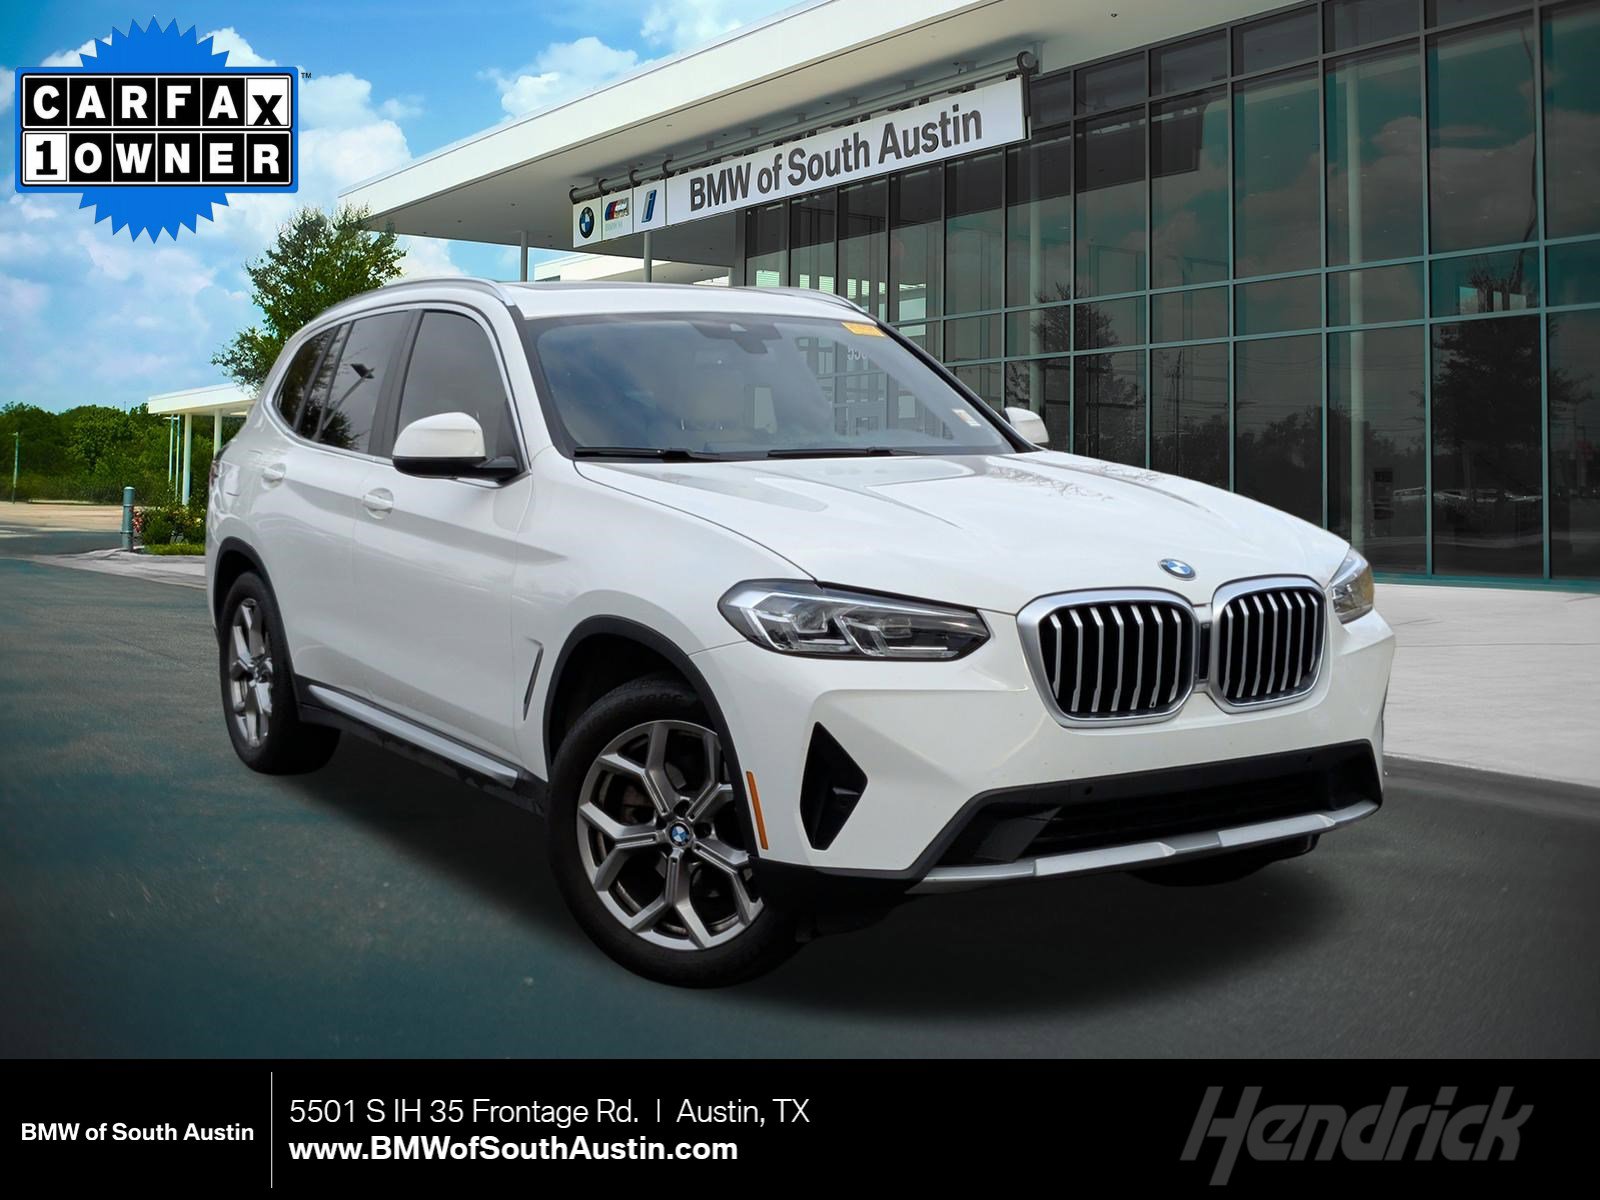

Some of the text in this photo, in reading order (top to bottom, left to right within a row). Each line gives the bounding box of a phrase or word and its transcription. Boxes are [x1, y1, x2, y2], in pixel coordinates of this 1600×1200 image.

[689, 103, 982, 212] BMW of South Austin
